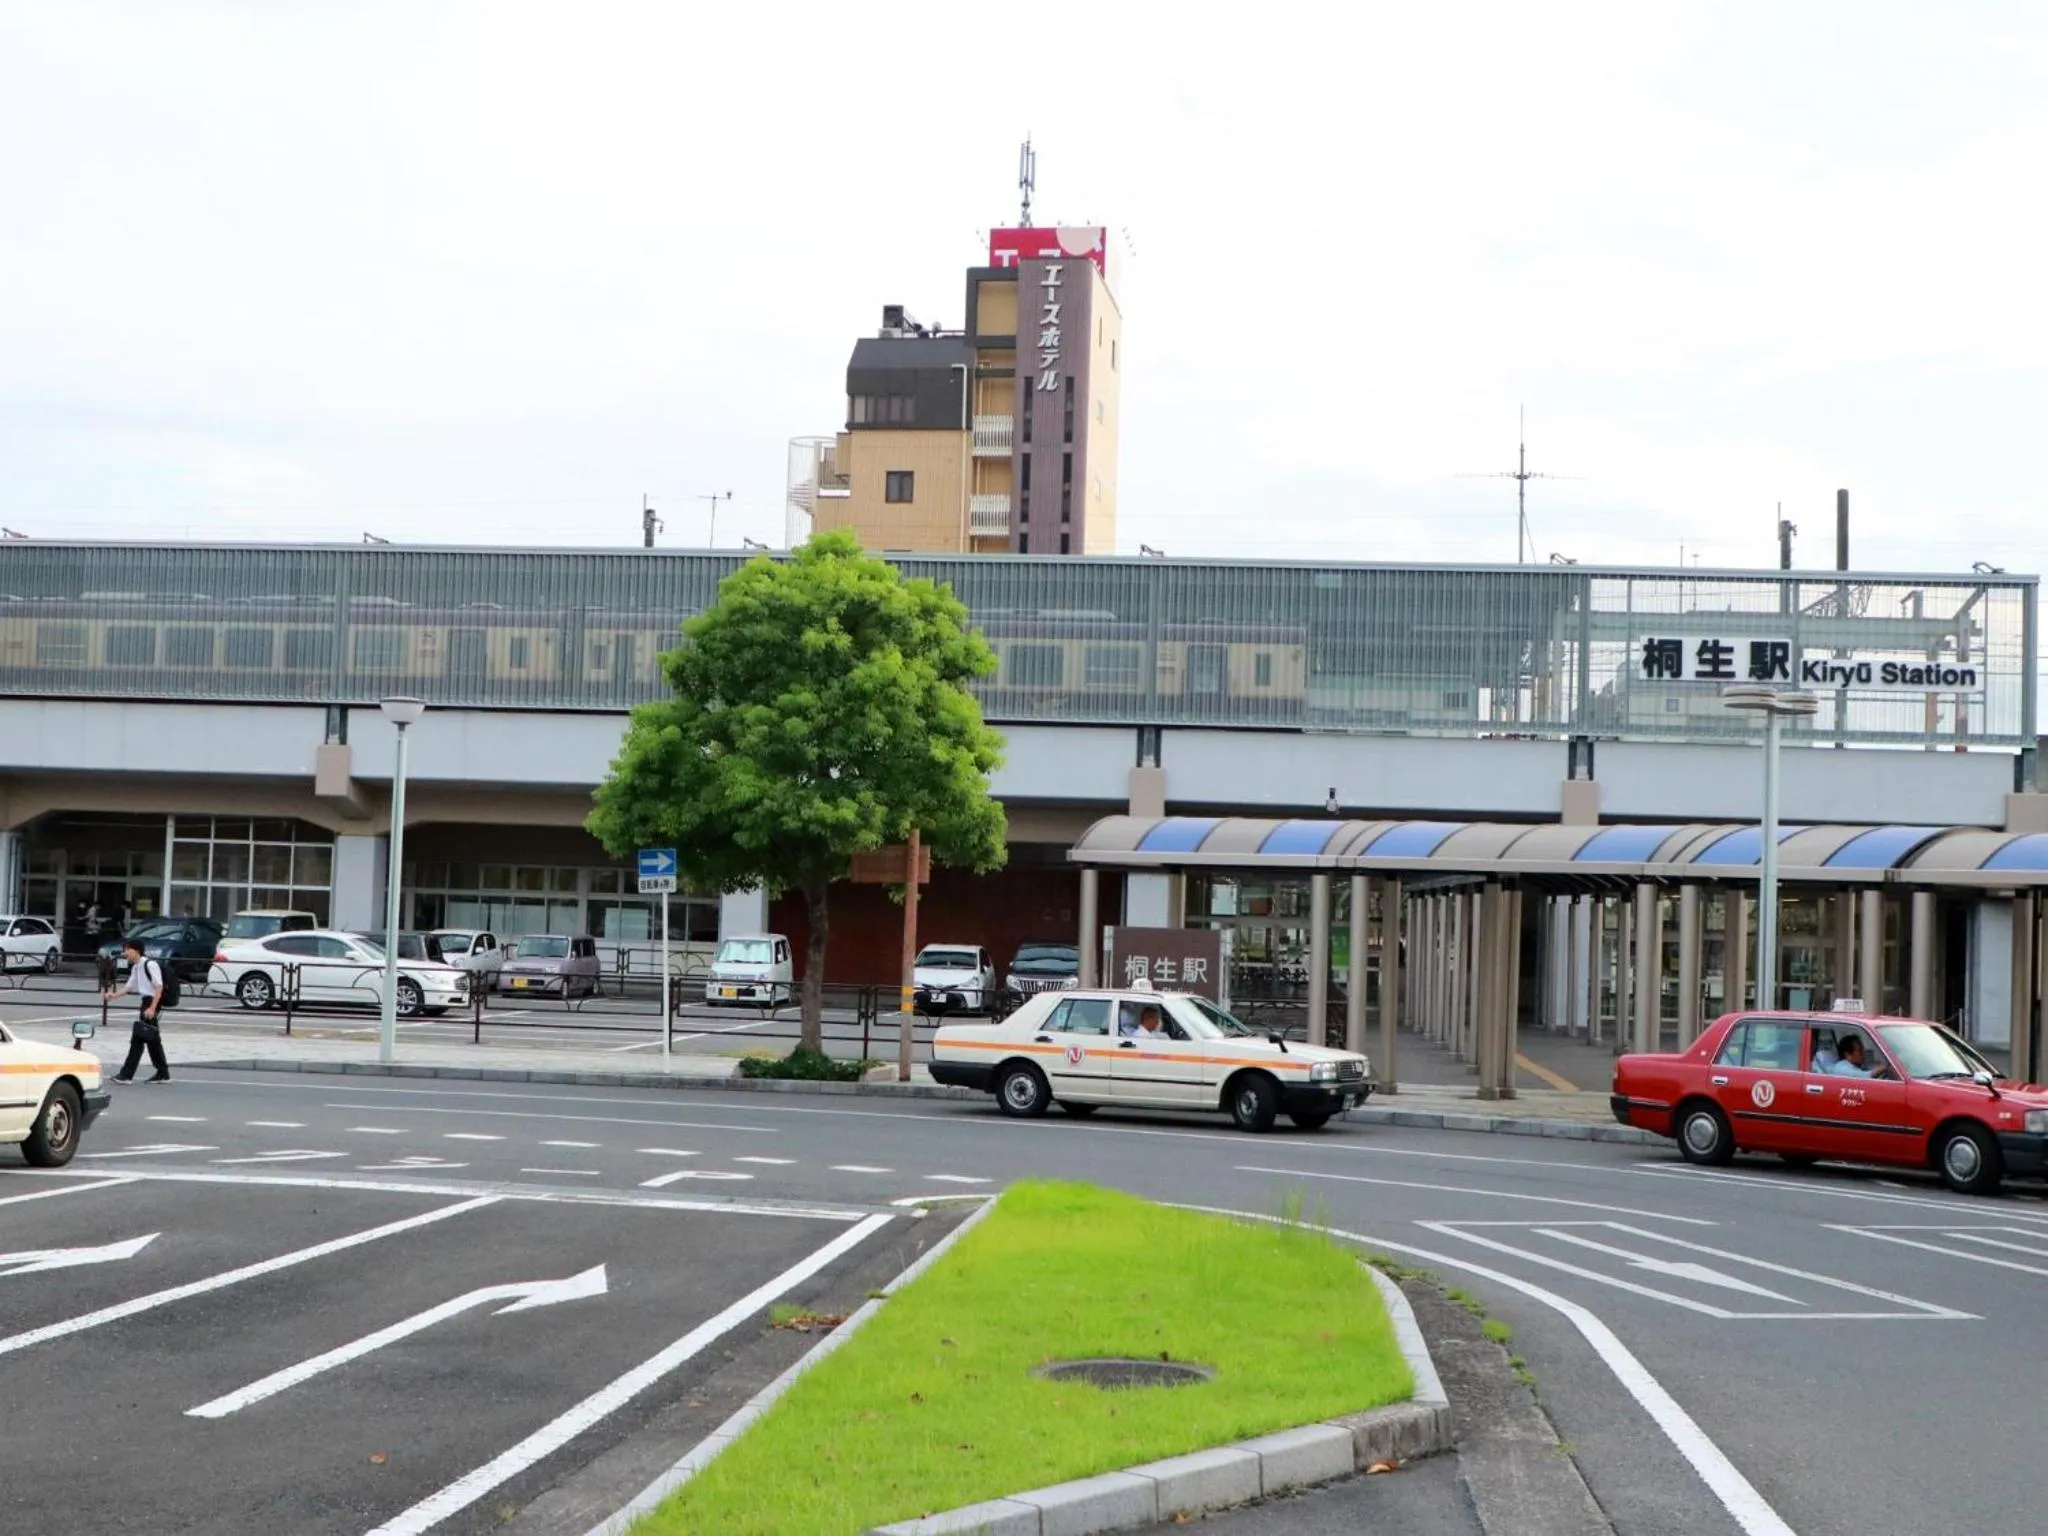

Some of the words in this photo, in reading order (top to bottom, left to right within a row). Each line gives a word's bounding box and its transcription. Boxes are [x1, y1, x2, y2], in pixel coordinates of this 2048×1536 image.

[1037, 265, 1063, 391] エースホテル
[1642, 637, 1790, 680] 桐生駅
[1801, 660, 1872, 689] Kiryū
[1880, 661, 1976, 686] Station
[1125, 954, 1208, 984] 桐生駅
